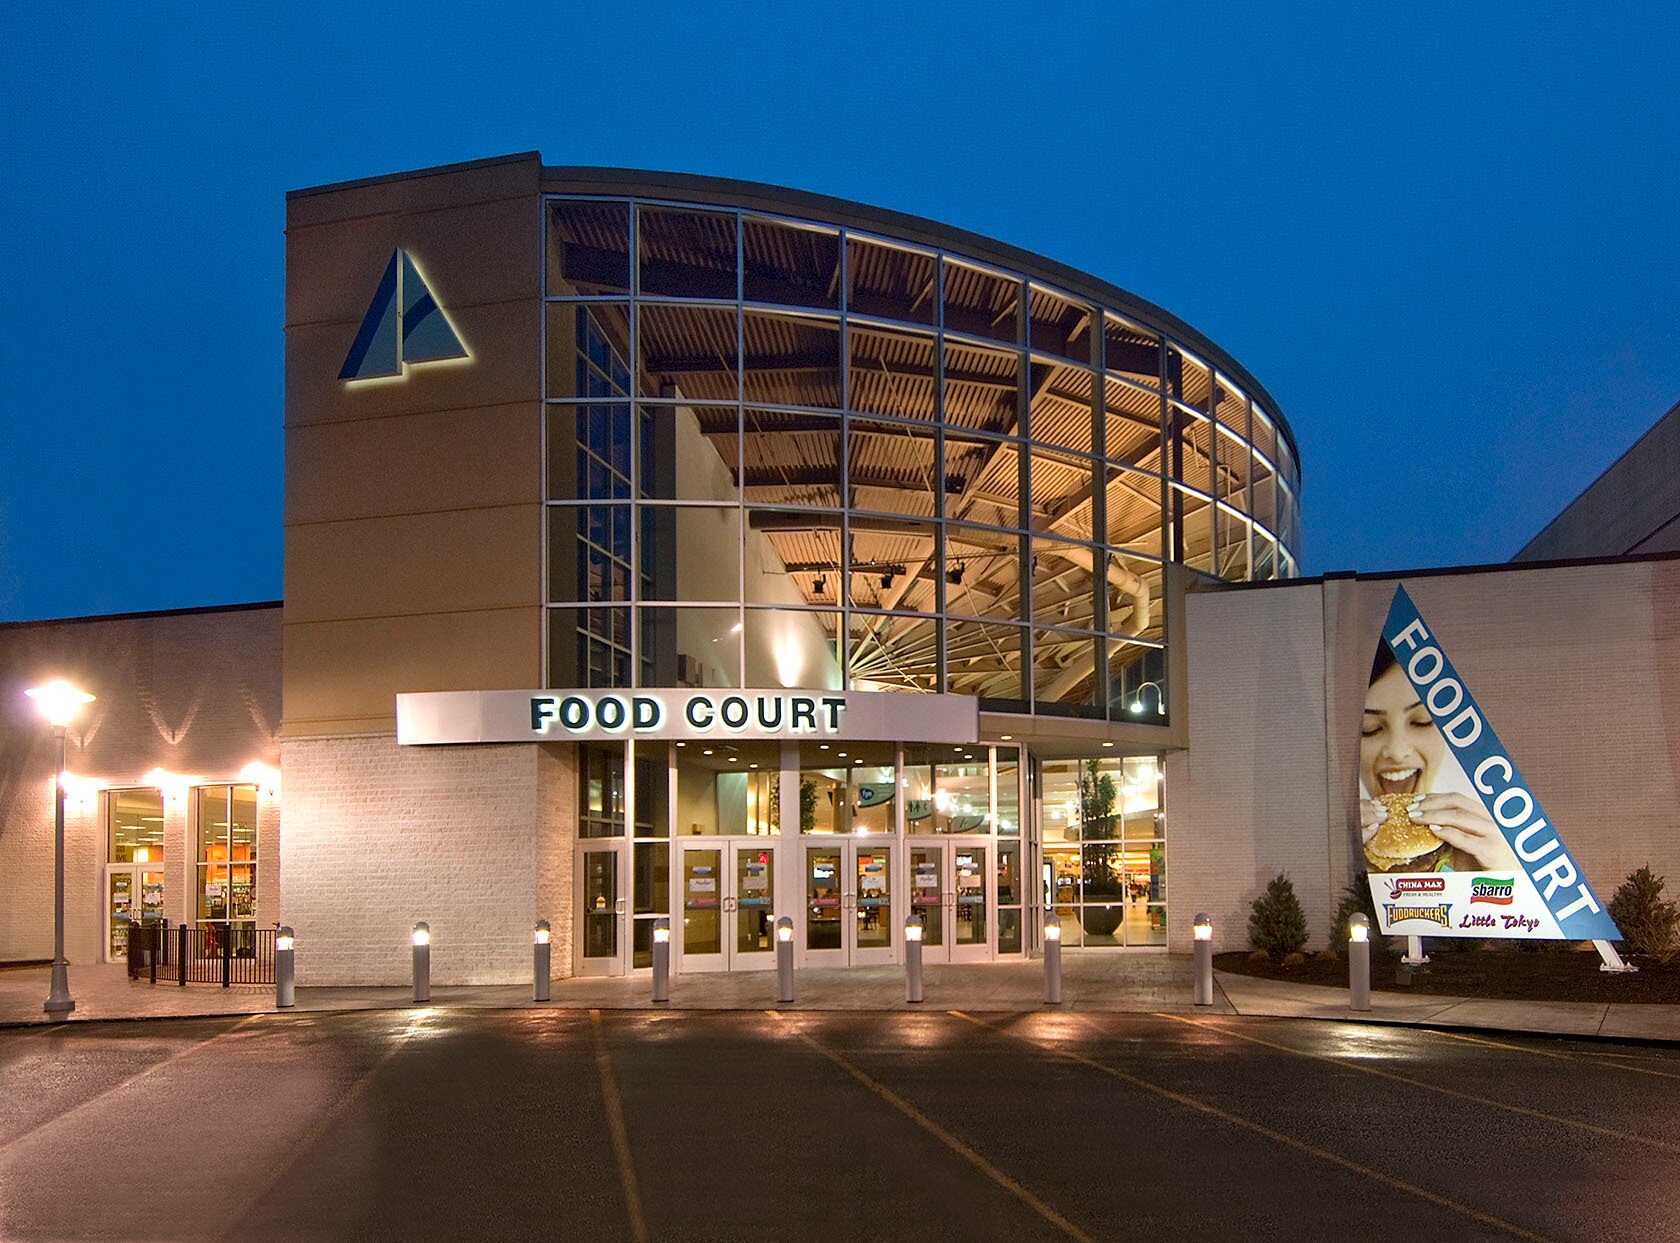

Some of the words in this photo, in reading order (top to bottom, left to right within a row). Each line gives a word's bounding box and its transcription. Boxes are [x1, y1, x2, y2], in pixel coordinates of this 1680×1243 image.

[531, 697, 661, 730] FOOD
[686, 696, 846, 731] COURT
[1391, 618, 1483, 748] FOOD
[1473, 755, 1600, 921] COURT
[1397, 881, 1423, 889] CHINA
[1424, 881, 1443, 889] MAX
[1472, 883, 1512, 896] sbarro
[1387, 905, 1448, 928] FUDDRUCKERS
[1458, 914, 1497, 929] Little
[1500, 914, 1540, 933] Tokyo
